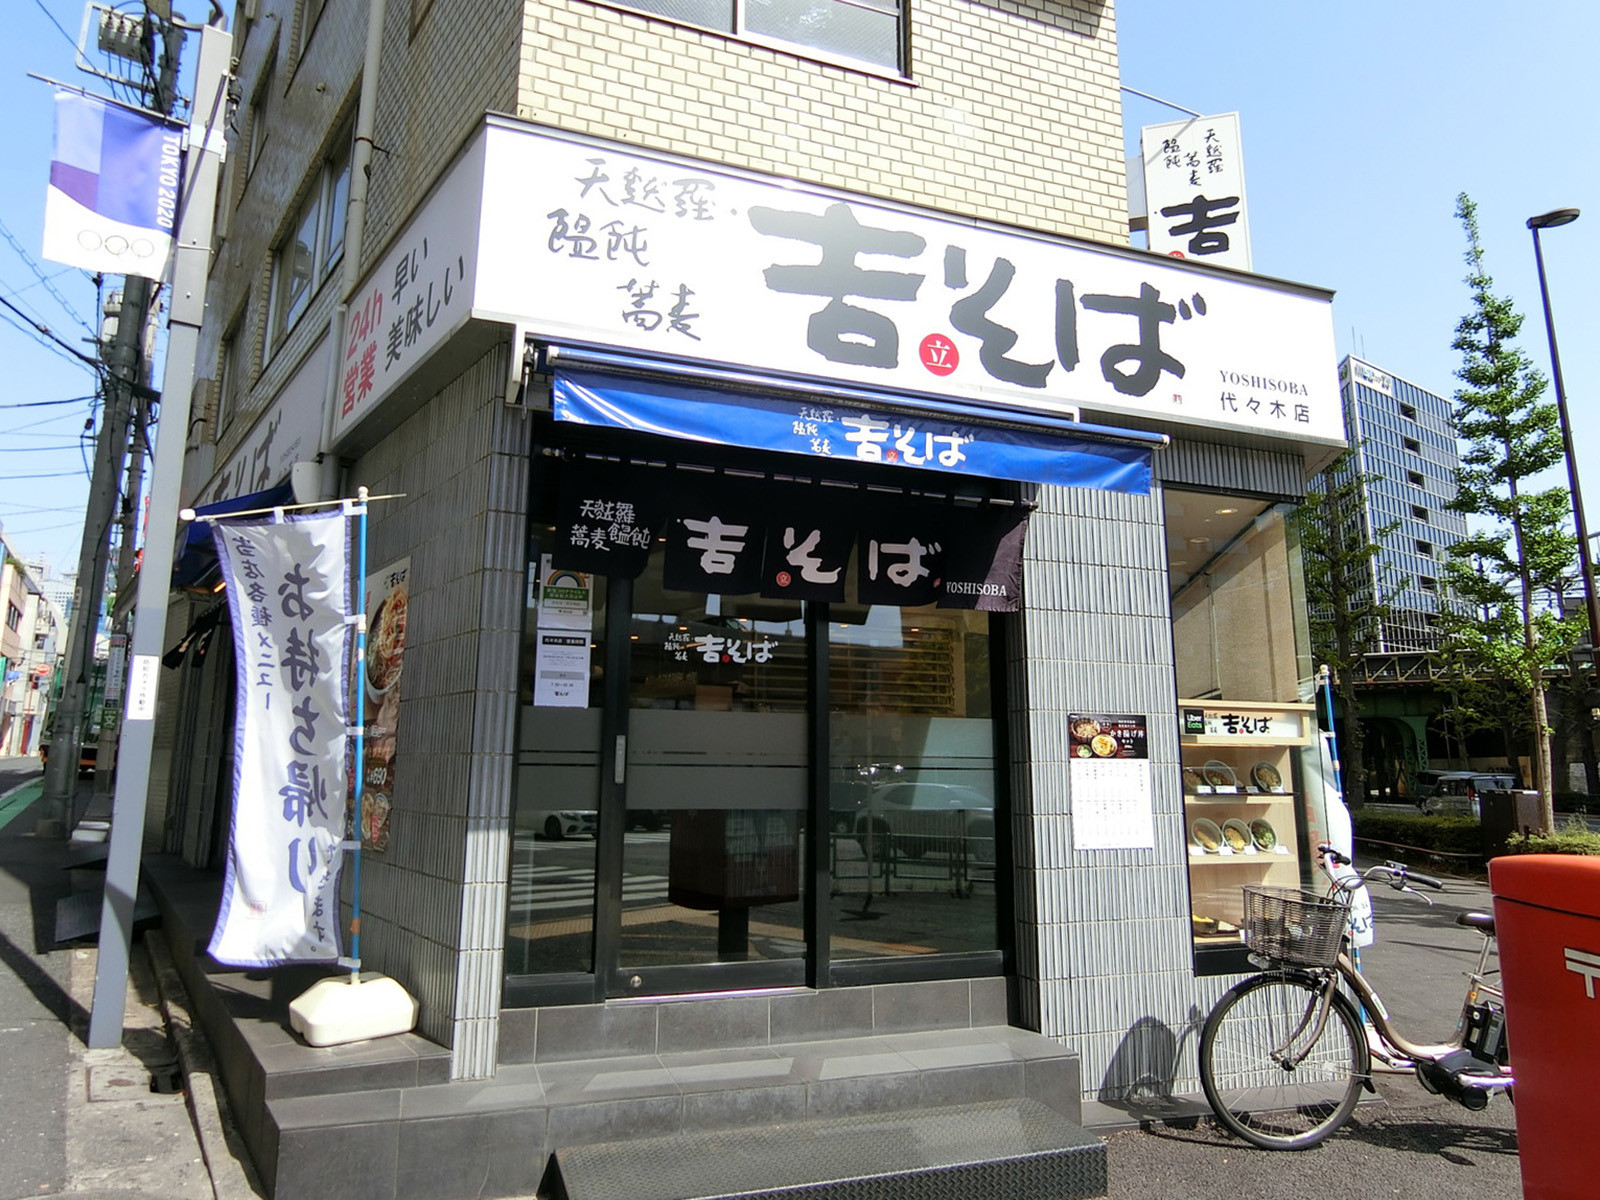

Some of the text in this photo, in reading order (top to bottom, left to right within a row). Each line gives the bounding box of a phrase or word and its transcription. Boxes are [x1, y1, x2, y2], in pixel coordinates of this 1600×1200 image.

[156, 135, 180, 229] TOKYO 2020
[1160, 194, 1240, 256] 吉
[392, 237, 428, 305] 早い
[747, 202, 1207, 398] 吉そば
[347, 288, 384, 361] 24h
[385, 255, 464, 372] 美味しい
[616, 278, 701, 341] 蕎麦
[342, 340, 378, 420] 営業
[926, 340, 953, 369] 立
[1219, 369, 1309, 396] YOSHISOBA
[1220, 391, 1310, 423] 代々木店
[841, 413, 975, 468] 吉そば
[683, 515, 942, 588] 吉そば
[946, 581, 1007, 597] YOSHISOBA
[694, 634, 779, 663] 吉そば
[1221, 713, 1273, 735] 吉そば
